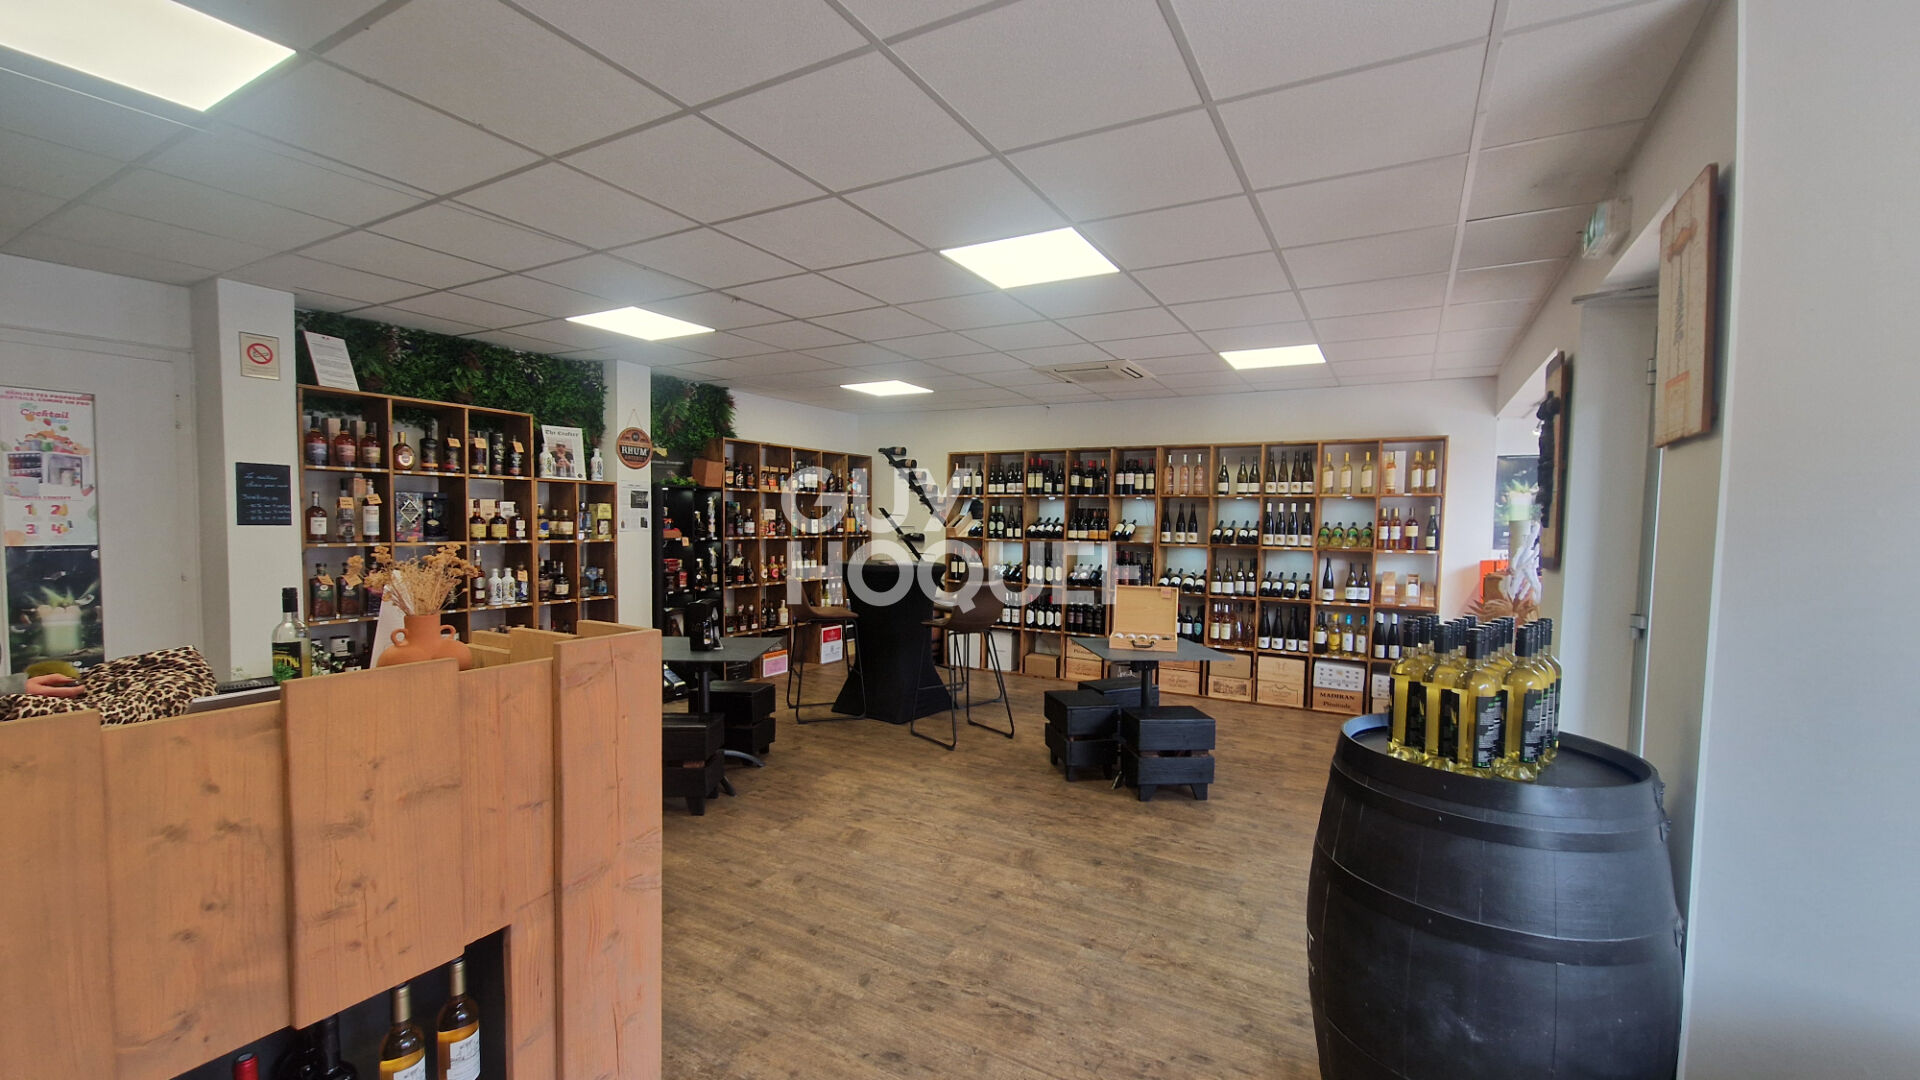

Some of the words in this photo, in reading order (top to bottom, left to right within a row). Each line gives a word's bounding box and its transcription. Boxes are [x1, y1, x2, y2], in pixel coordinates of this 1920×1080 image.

[621, 445, 649, 456] RHUM
[25, 504, 33, 515] 1
[50, 504, 61, 515] 2
[25, 524, 35, 534] 3
[1320, 692, 1355, 701] MADIRAN
